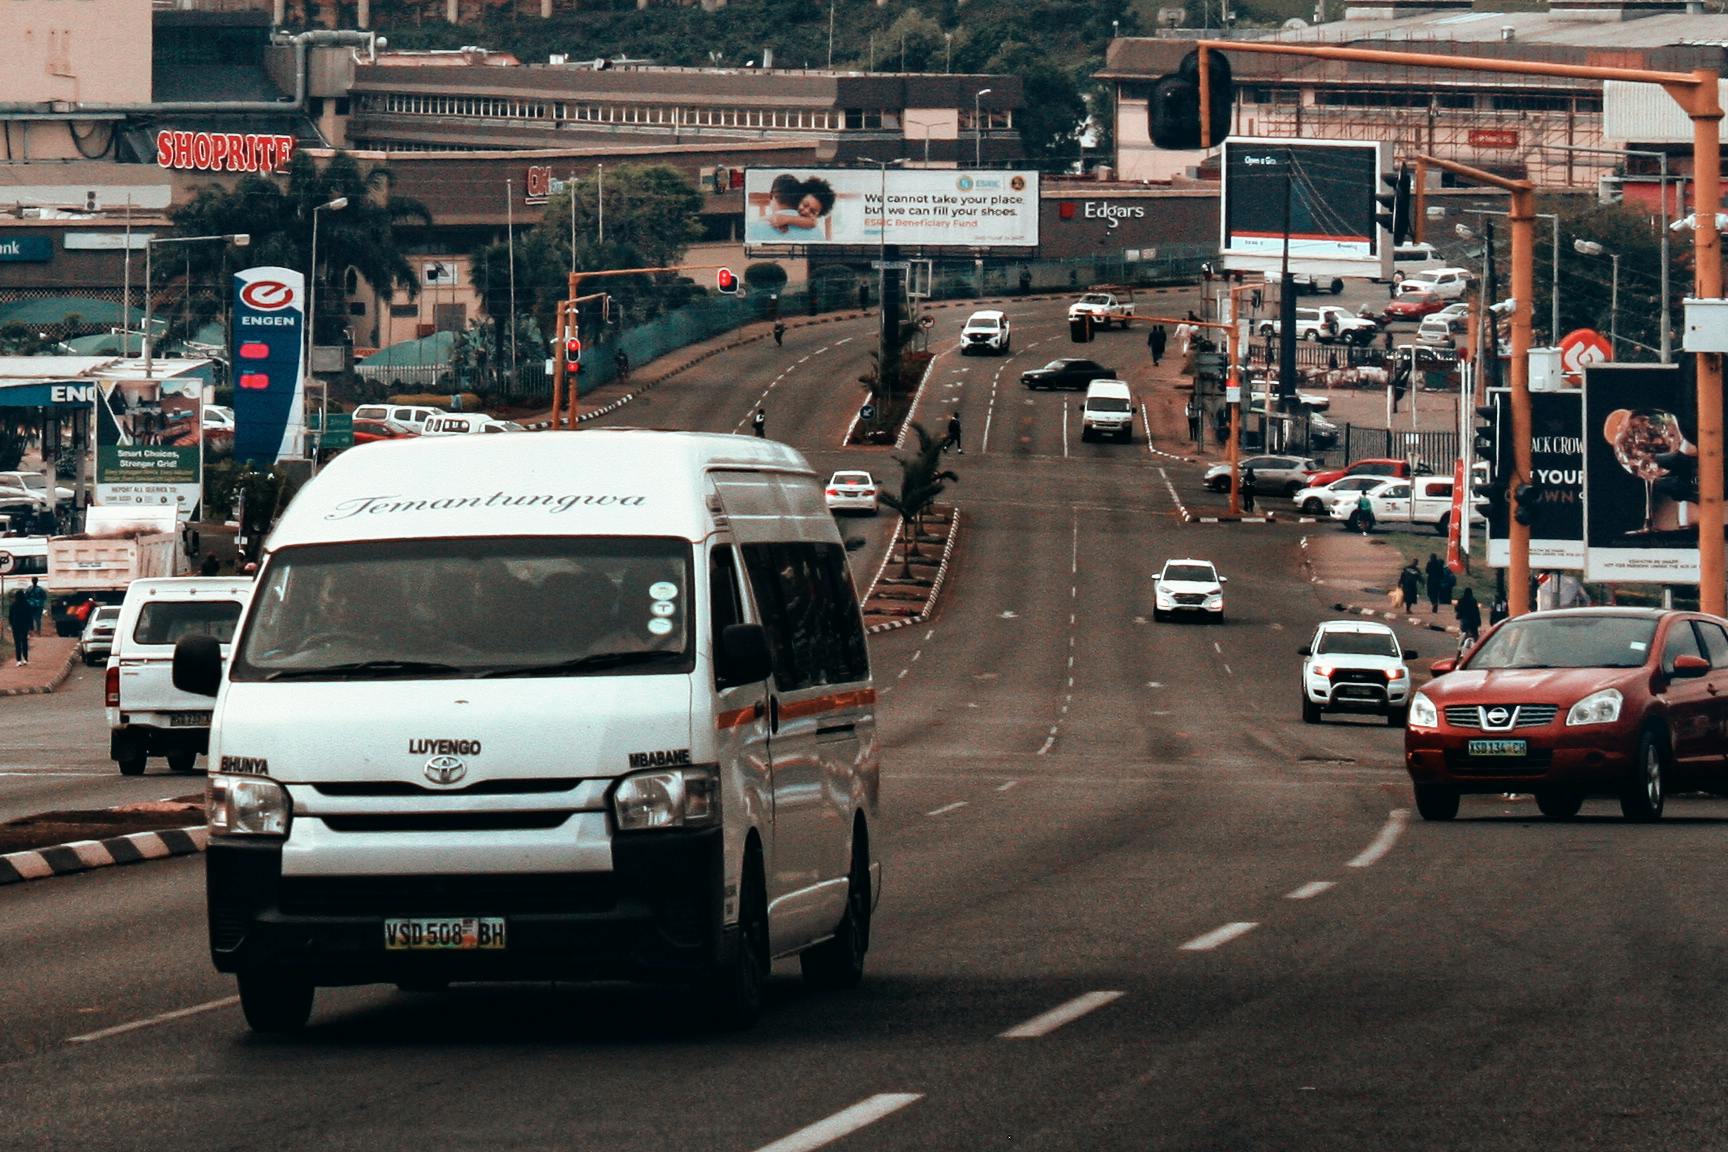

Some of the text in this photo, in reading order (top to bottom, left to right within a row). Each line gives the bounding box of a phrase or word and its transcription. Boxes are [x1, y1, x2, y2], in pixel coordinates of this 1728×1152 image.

[157, 130, 293, 174] SHOPRITE
[864, 194, 883, 203] We
[887, 194, 928, 203] cannot
[932, 194, 958, 203] take
[960, 196, 987, 206] your
[864, 206, 883, 215] but
[933, 206, 948, 216] fill
[951, 208, 978, 217] your
[1084, 201, 1145, 228] Edgars
[895, 219, 951, 228] Beneficiary
[953, 219, 978, 228] Fund
[242, 317, 295, 326] ENGEN
[1531, 436, 1551, 452] ACK
[324, 491, 647, 521] Temantungwa
[408, 739, 482, 756] LUYENGO
[221, 756, 269, 775] BHUNYA
[629, 750, 691, 768] MBABANE
[479, 923, 504, 945] BH
